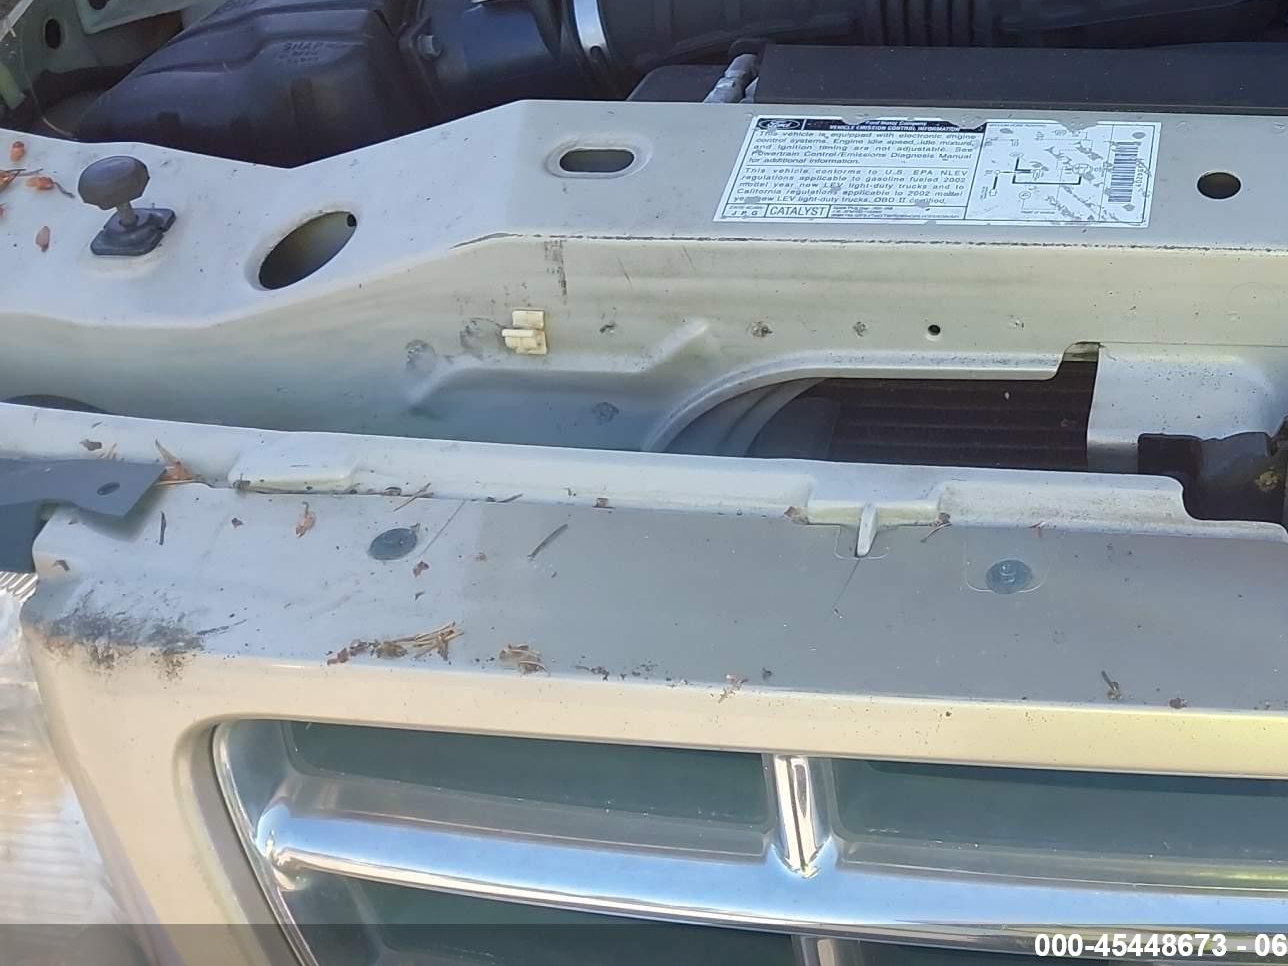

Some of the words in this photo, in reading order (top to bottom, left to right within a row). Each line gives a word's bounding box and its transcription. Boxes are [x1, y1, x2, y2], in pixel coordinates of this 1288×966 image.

[778, 143, 812, 151] ignition
[819, 144, 848, 152] timing
[797, 196, 841, 204] light-duty
[769, 206, 829, 216] CATALYST
